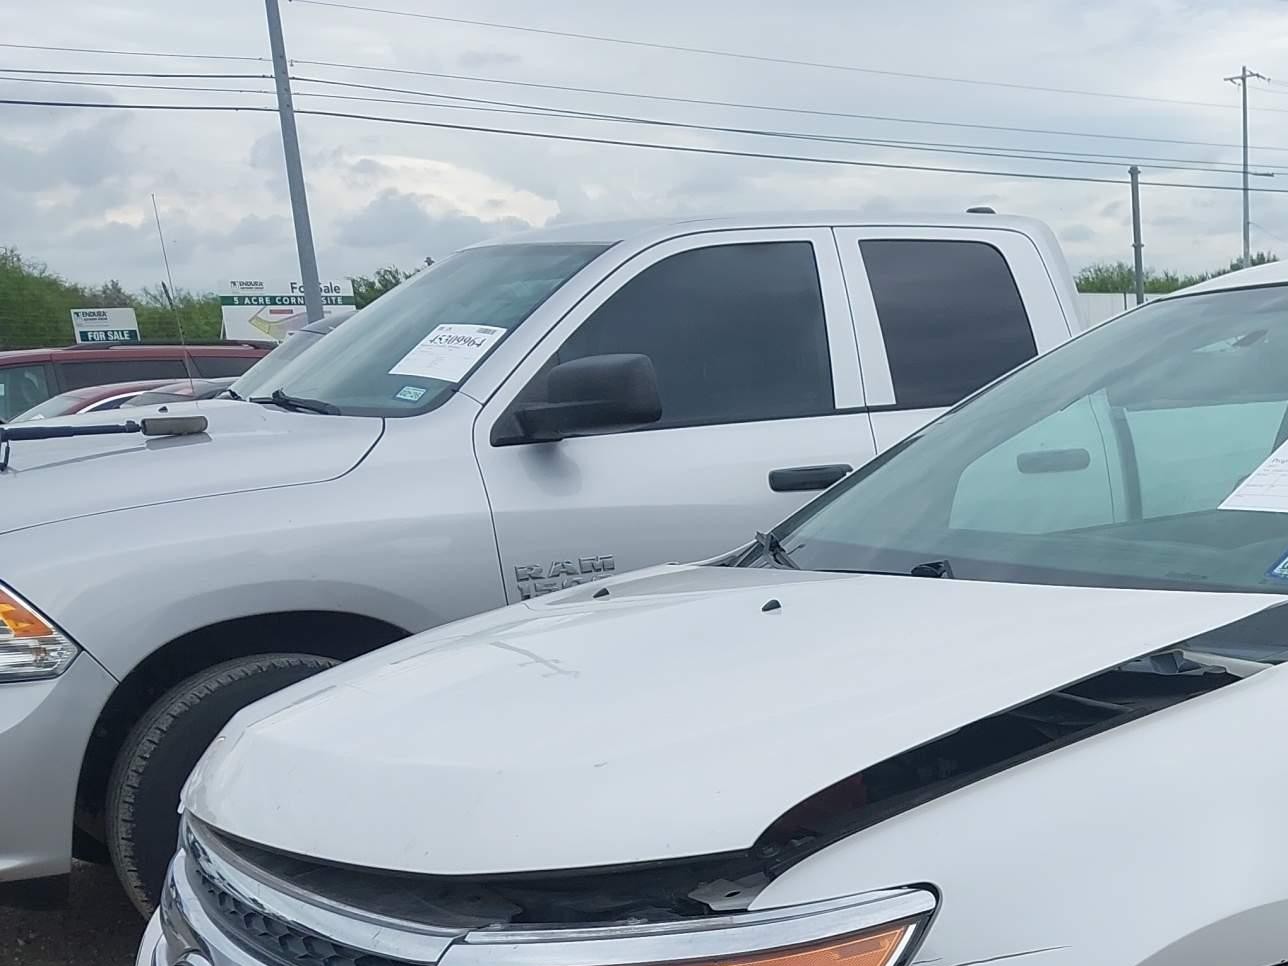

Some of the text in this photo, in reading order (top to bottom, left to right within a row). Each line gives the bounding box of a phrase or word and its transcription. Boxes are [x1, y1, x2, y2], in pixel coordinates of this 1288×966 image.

[290, 281, 305, 294] Fo
[276, 296, 305, 304] CORN
[321, 297, 343, 305] SITE
[87, 330, 131, 341] FOR SALE
[514, 554, 616, 583] RAM
